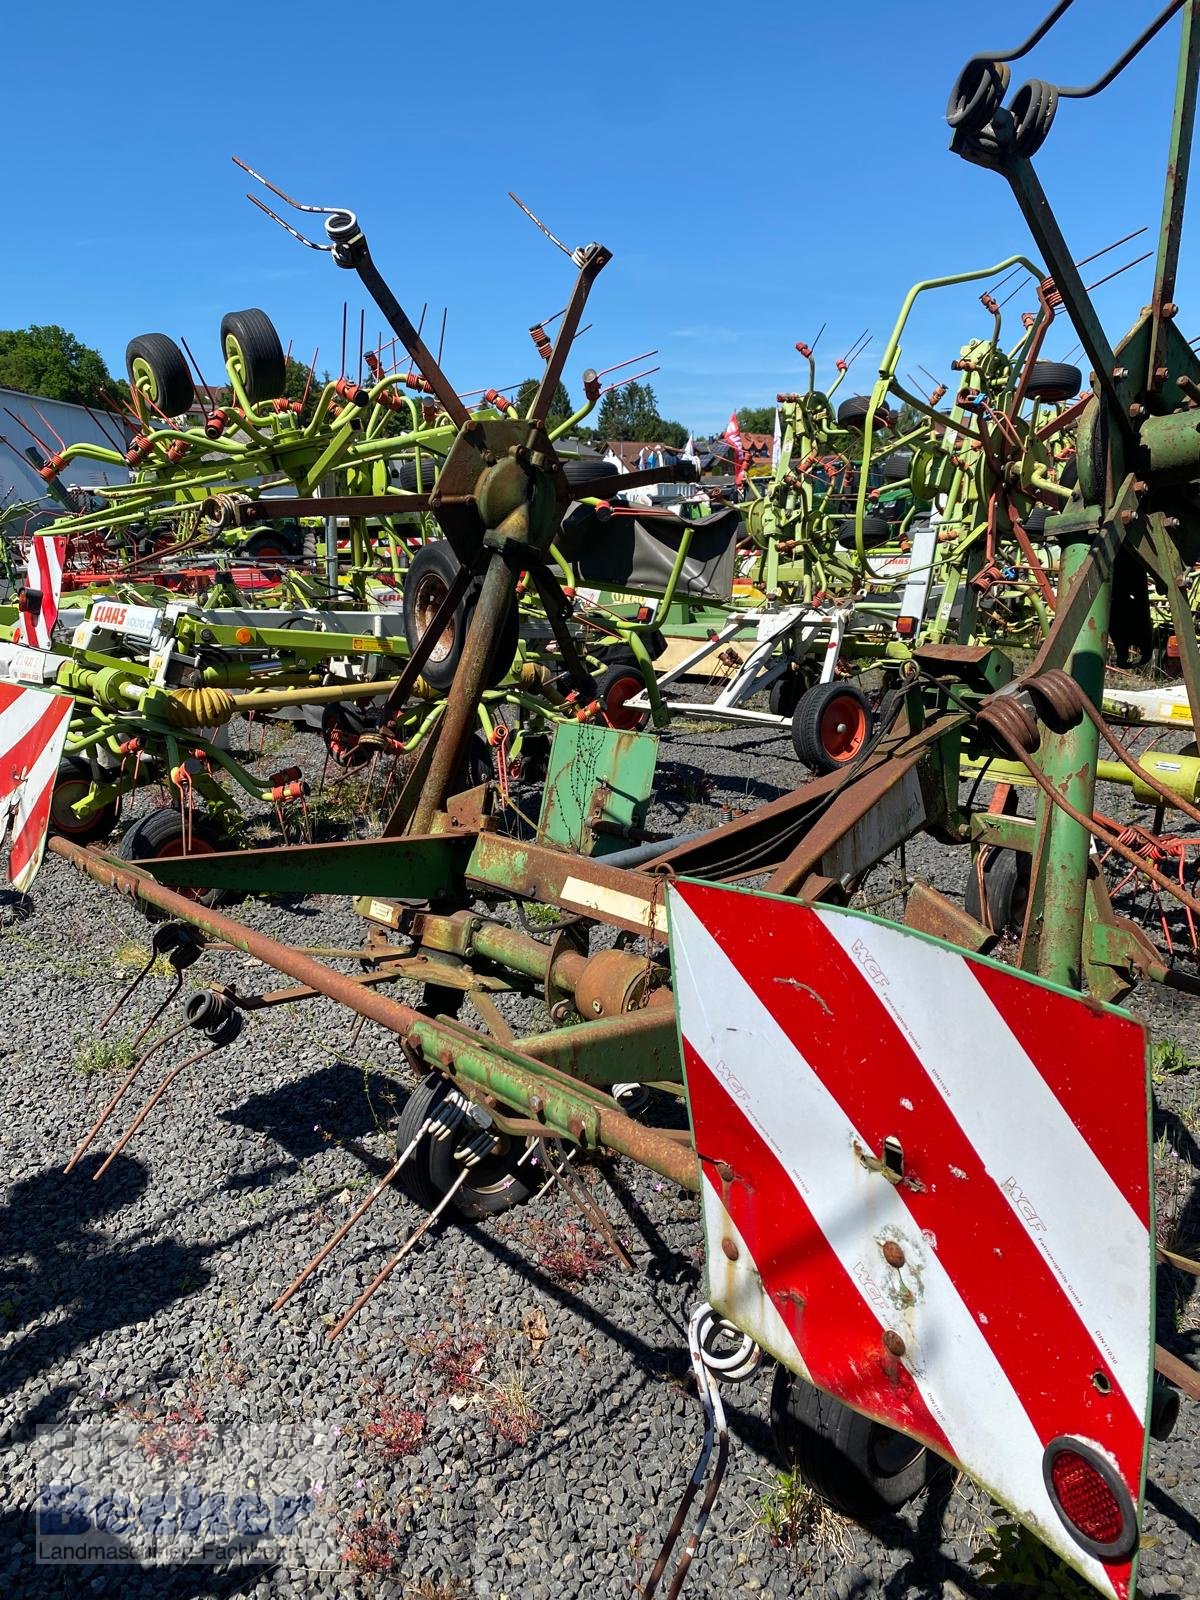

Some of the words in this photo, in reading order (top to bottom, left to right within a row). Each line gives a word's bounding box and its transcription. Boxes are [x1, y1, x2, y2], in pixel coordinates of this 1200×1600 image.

[94, 606, 128, 625] CLAAS
[851, 938, 890, 987] WGF
[716, 1060, 751, 1100] WGF
[1002, 1176, 1047, 1232] WGF
[853, 1261, 889, 1309] WGF
